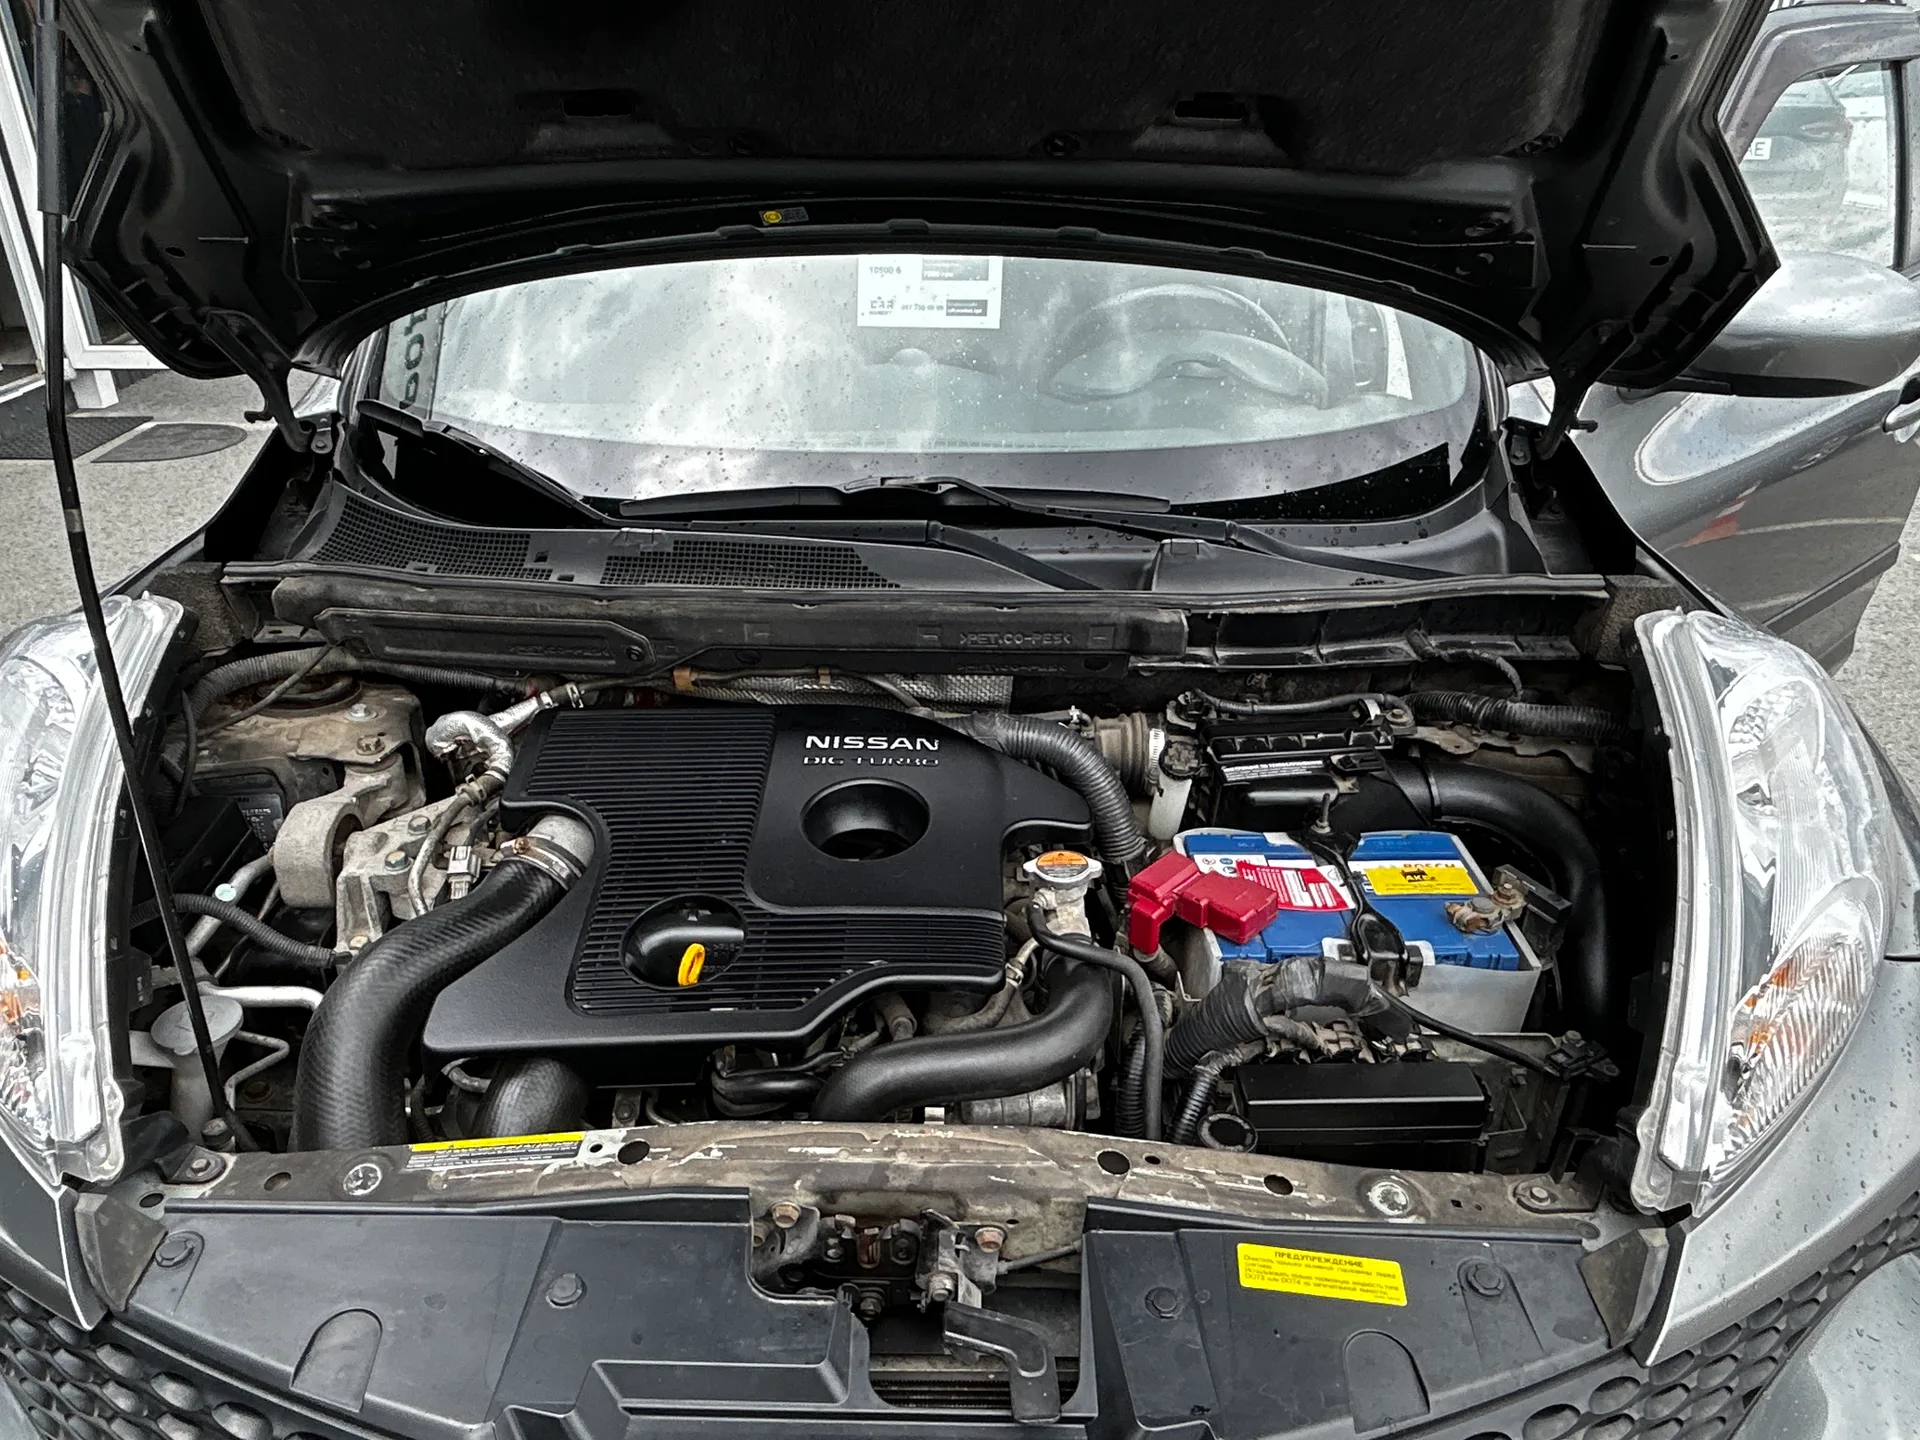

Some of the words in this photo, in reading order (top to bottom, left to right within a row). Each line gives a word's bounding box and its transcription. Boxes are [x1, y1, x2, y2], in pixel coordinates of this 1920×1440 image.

[805, 735, 940, 751] NISSAN
[803, 756, 845, 766] DIG
[851, 756, 940, 767] TURBO
[1274, 1251, 1363, 1267] ПРЕДУПРЕЖДЕНИЕ
